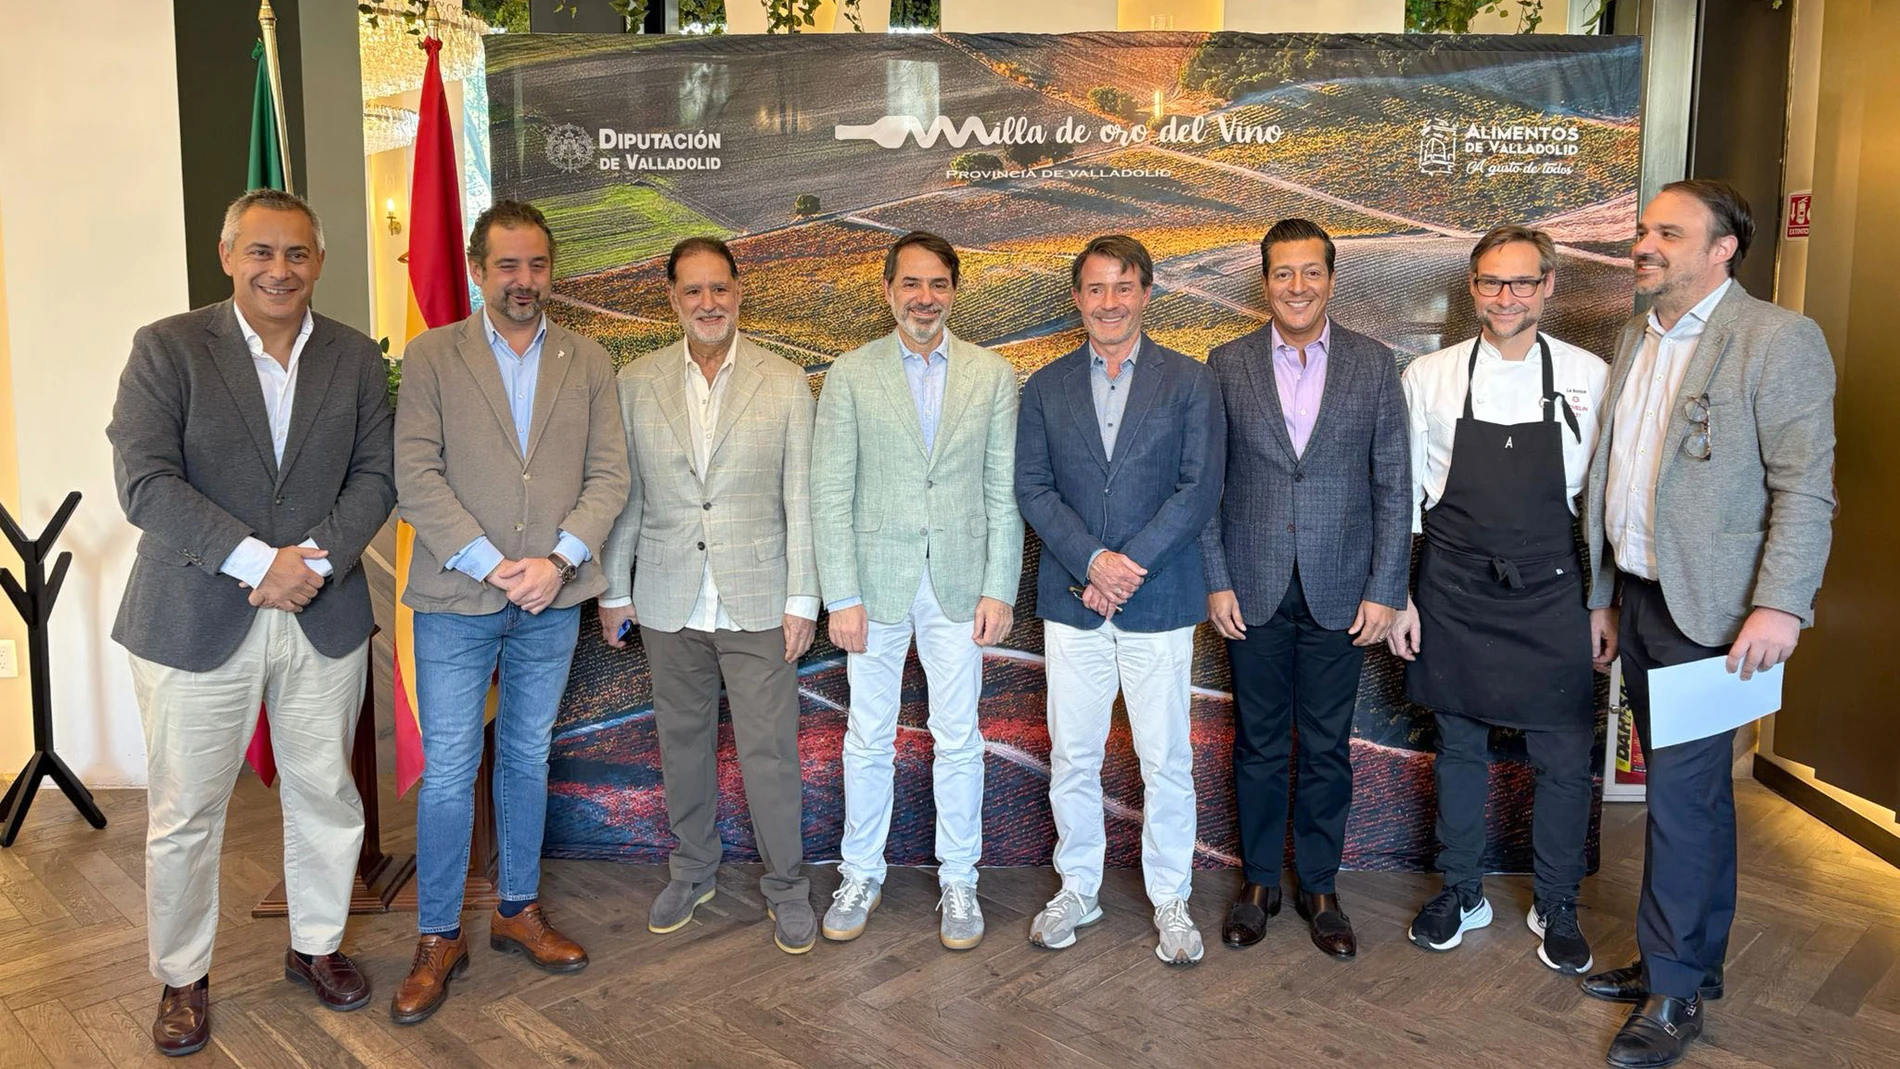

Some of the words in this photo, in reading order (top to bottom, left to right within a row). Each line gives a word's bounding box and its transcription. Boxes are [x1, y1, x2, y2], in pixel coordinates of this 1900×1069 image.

[599, 127, 721, 150] DIPUTACIÓN
[1056, 115, 1090, 145] de
[1099, 121, 1149, 146] oro
[1158, 114, 1213, 147] del
[1217, 113, 1286, 145] Vino
[1465, 122, 1580, 141] ALIMENTOS
[1465, 142, 1484, 153] DE
[1487, 141, 1579, 156] VALLADOLID
[600, 157, 620, 171] DE
[626, 153, 721, 171] VALLADOLID
[1488, 161, 1523, 177] gusto
[1523, 160, 1541, 175] de
[1541, 161, 1574, 175] todos
[946, 169, 1037, 179] PROVINCIA
[1042, 169, 1063, 179] DE
[1068, 168, 1172, 179] VALLADOLID
[1504, 436, 1514, 449] A
